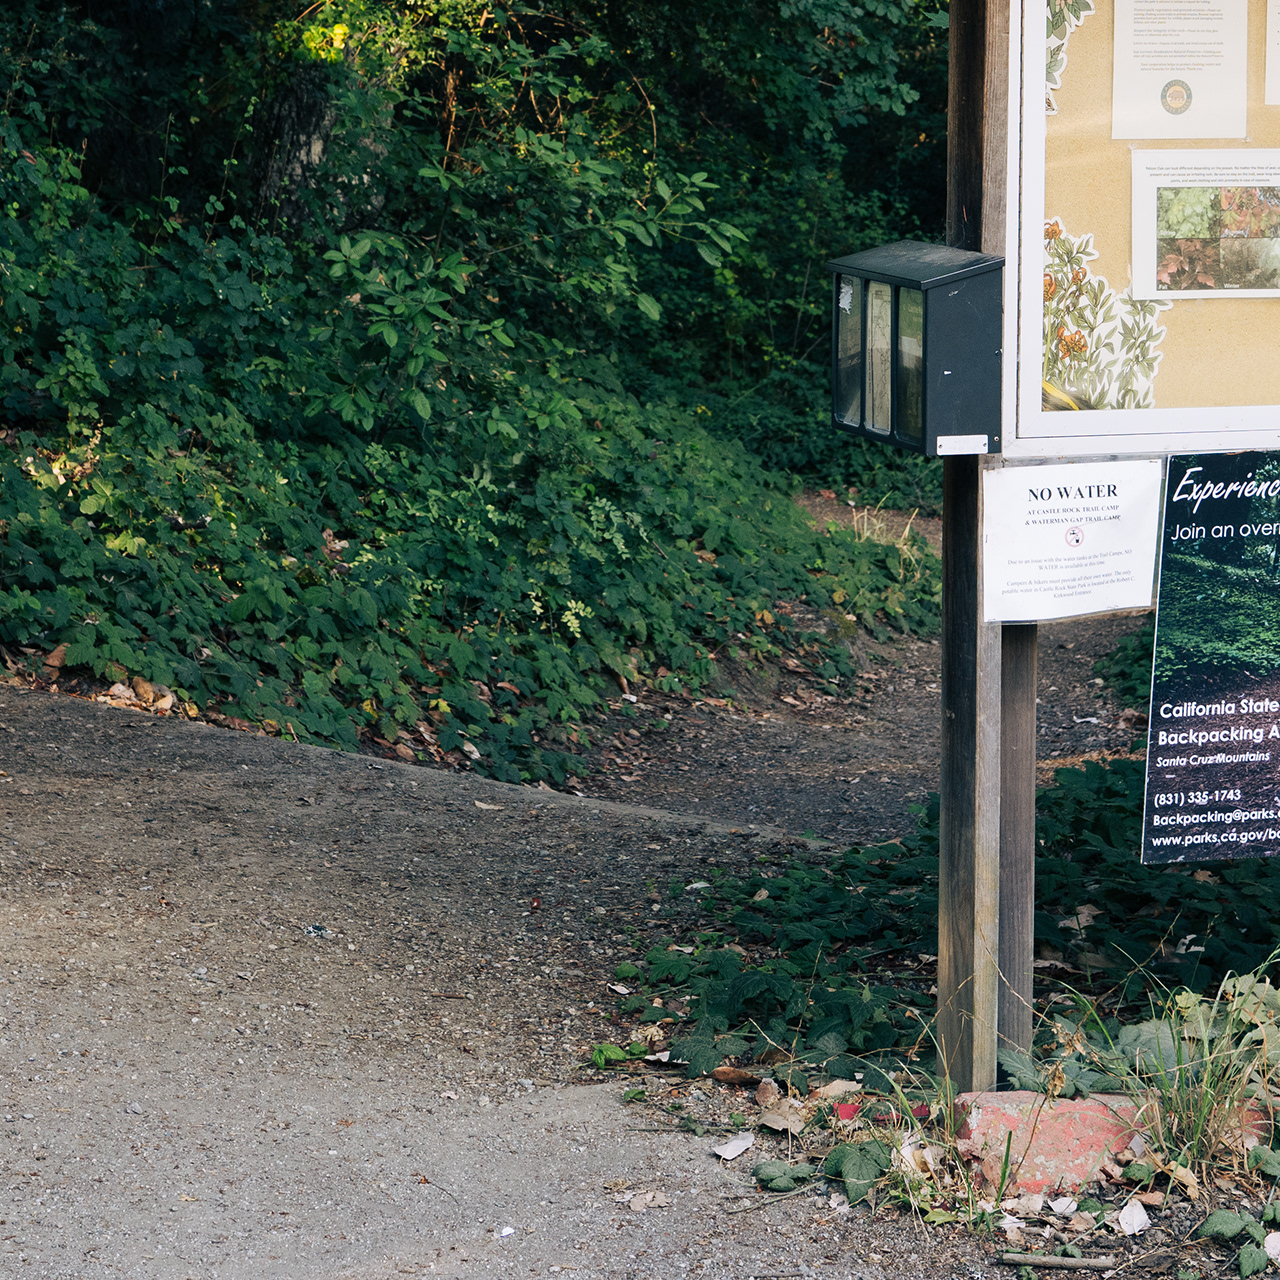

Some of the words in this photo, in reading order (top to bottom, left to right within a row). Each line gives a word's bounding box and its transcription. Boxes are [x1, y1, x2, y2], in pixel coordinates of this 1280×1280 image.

[1028, 487, 1052, 502] NO
[1057, 483, 1118, 500] WATER
[1171, 523, 1206, 541] Join
[1211, 524, 1234, 538] an
[1159, 700, 1236, 719] California
[1239, 698, 1280, 715] State
[1158, 725, 1265, 747] Backpacking
[1155, 754, 1188, 768] Santa
[1189, 753, 1213, 766] Cruz
[1214, 750, 1271, 765] Mountains
[1154, 792, 1185, 809] (831)
[1187, 789, 1242, 804] 335-1743
